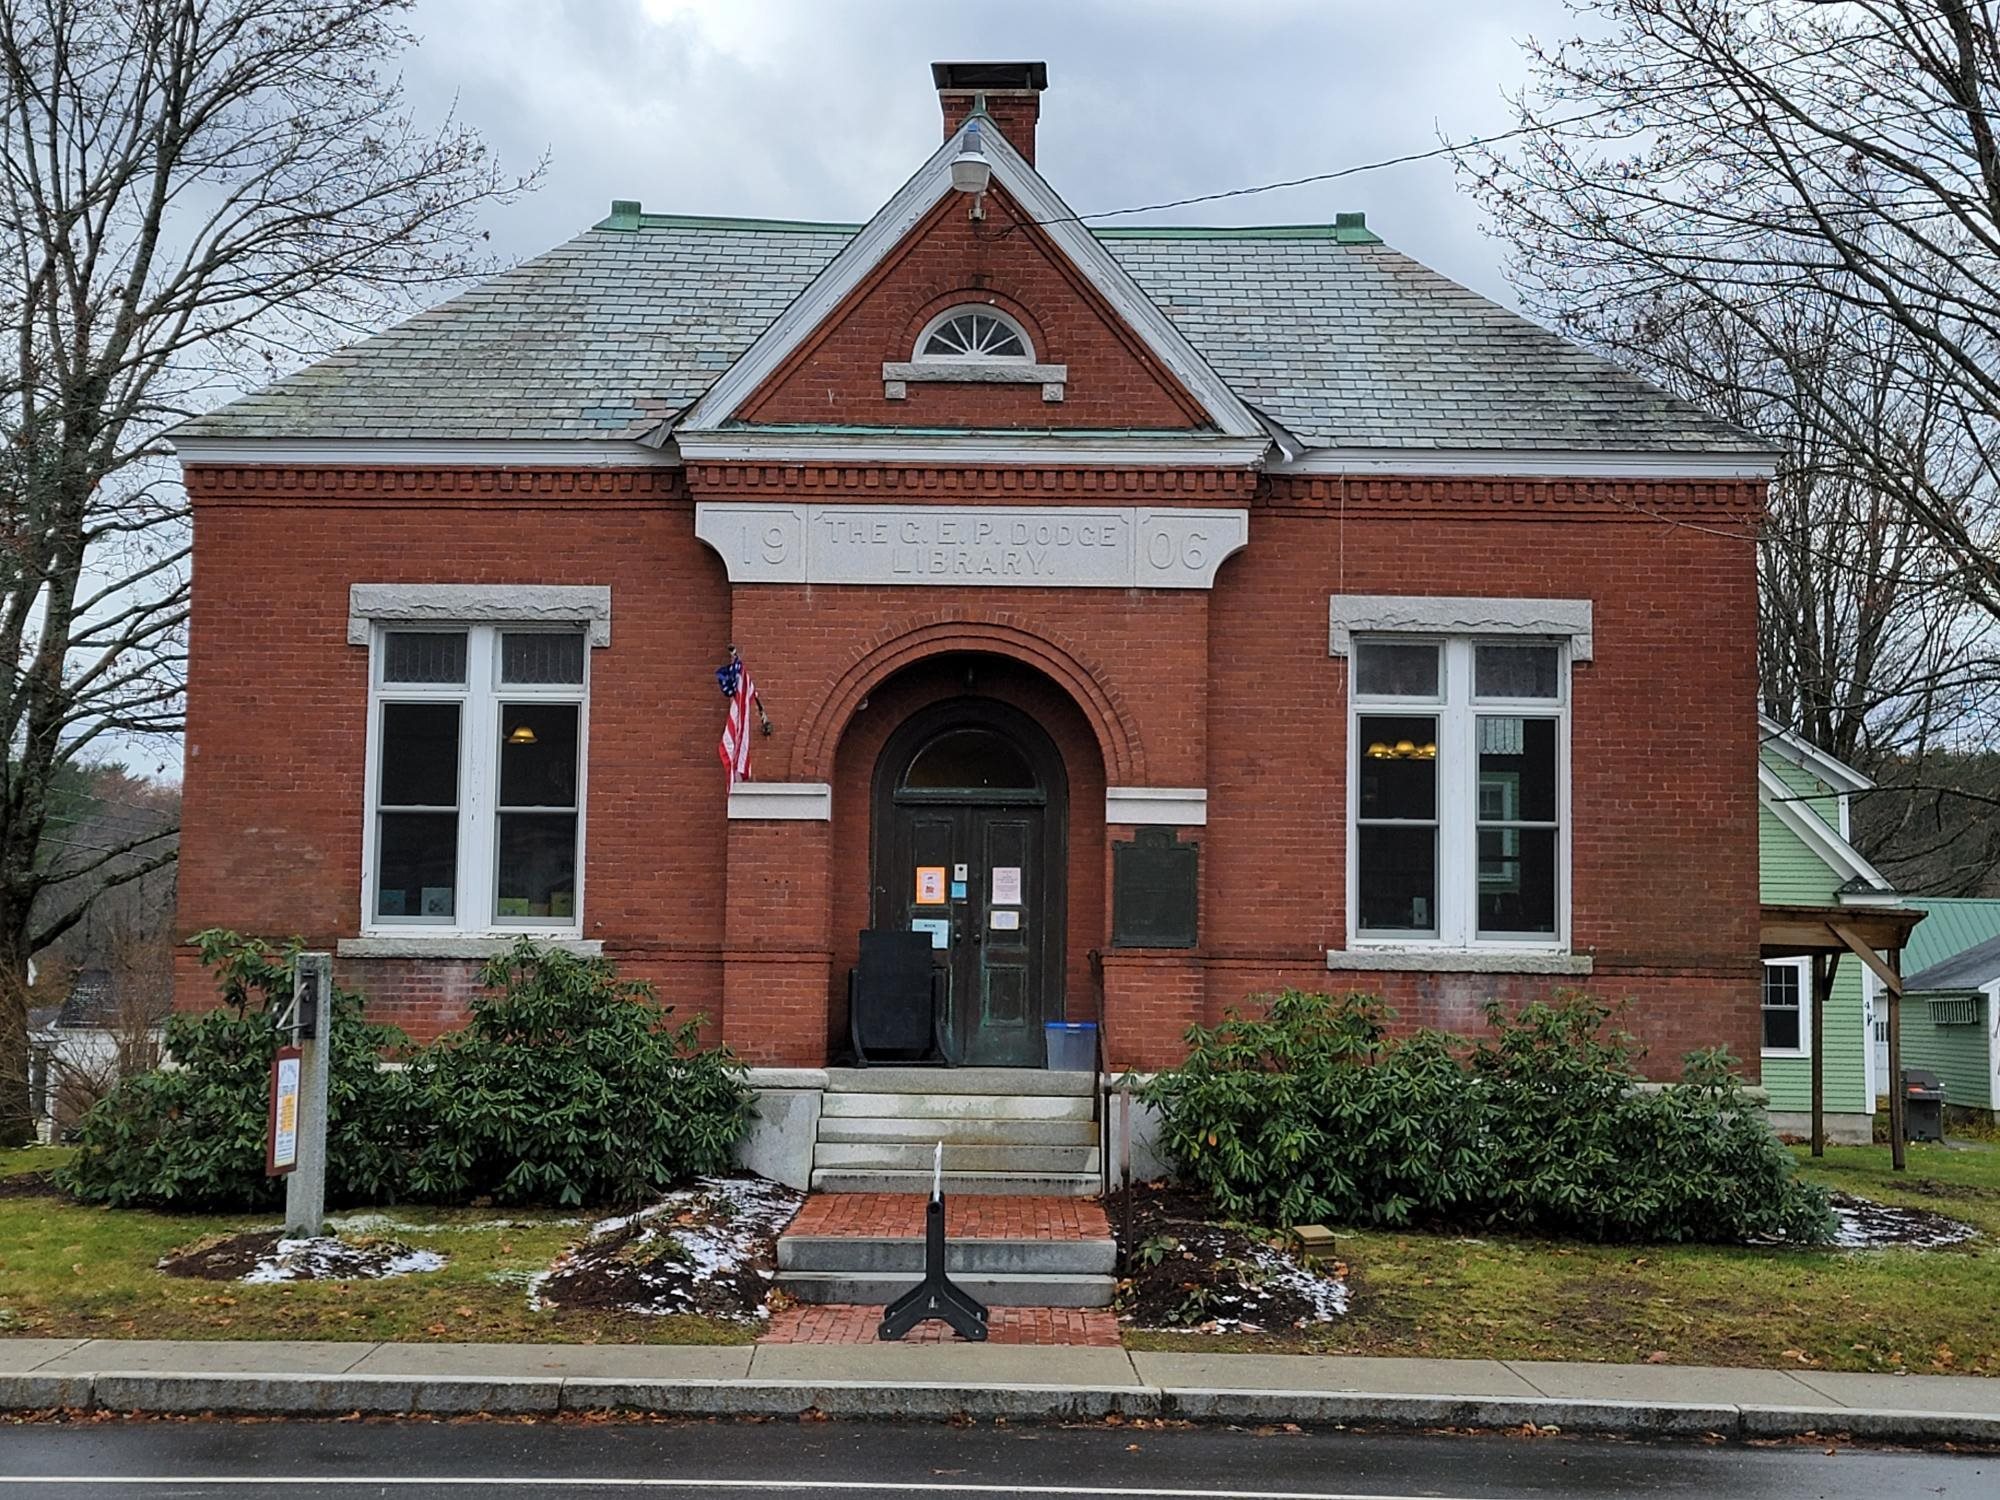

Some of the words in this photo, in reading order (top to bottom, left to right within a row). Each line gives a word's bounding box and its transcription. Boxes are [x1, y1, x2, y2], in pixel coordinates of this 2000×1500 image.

[741, 526, 788, 565] 19
[823, 518, 888, 543] THE
[1010, 523, 1116, 547] DODGE
[1147, 532, 1208, 570] 06
